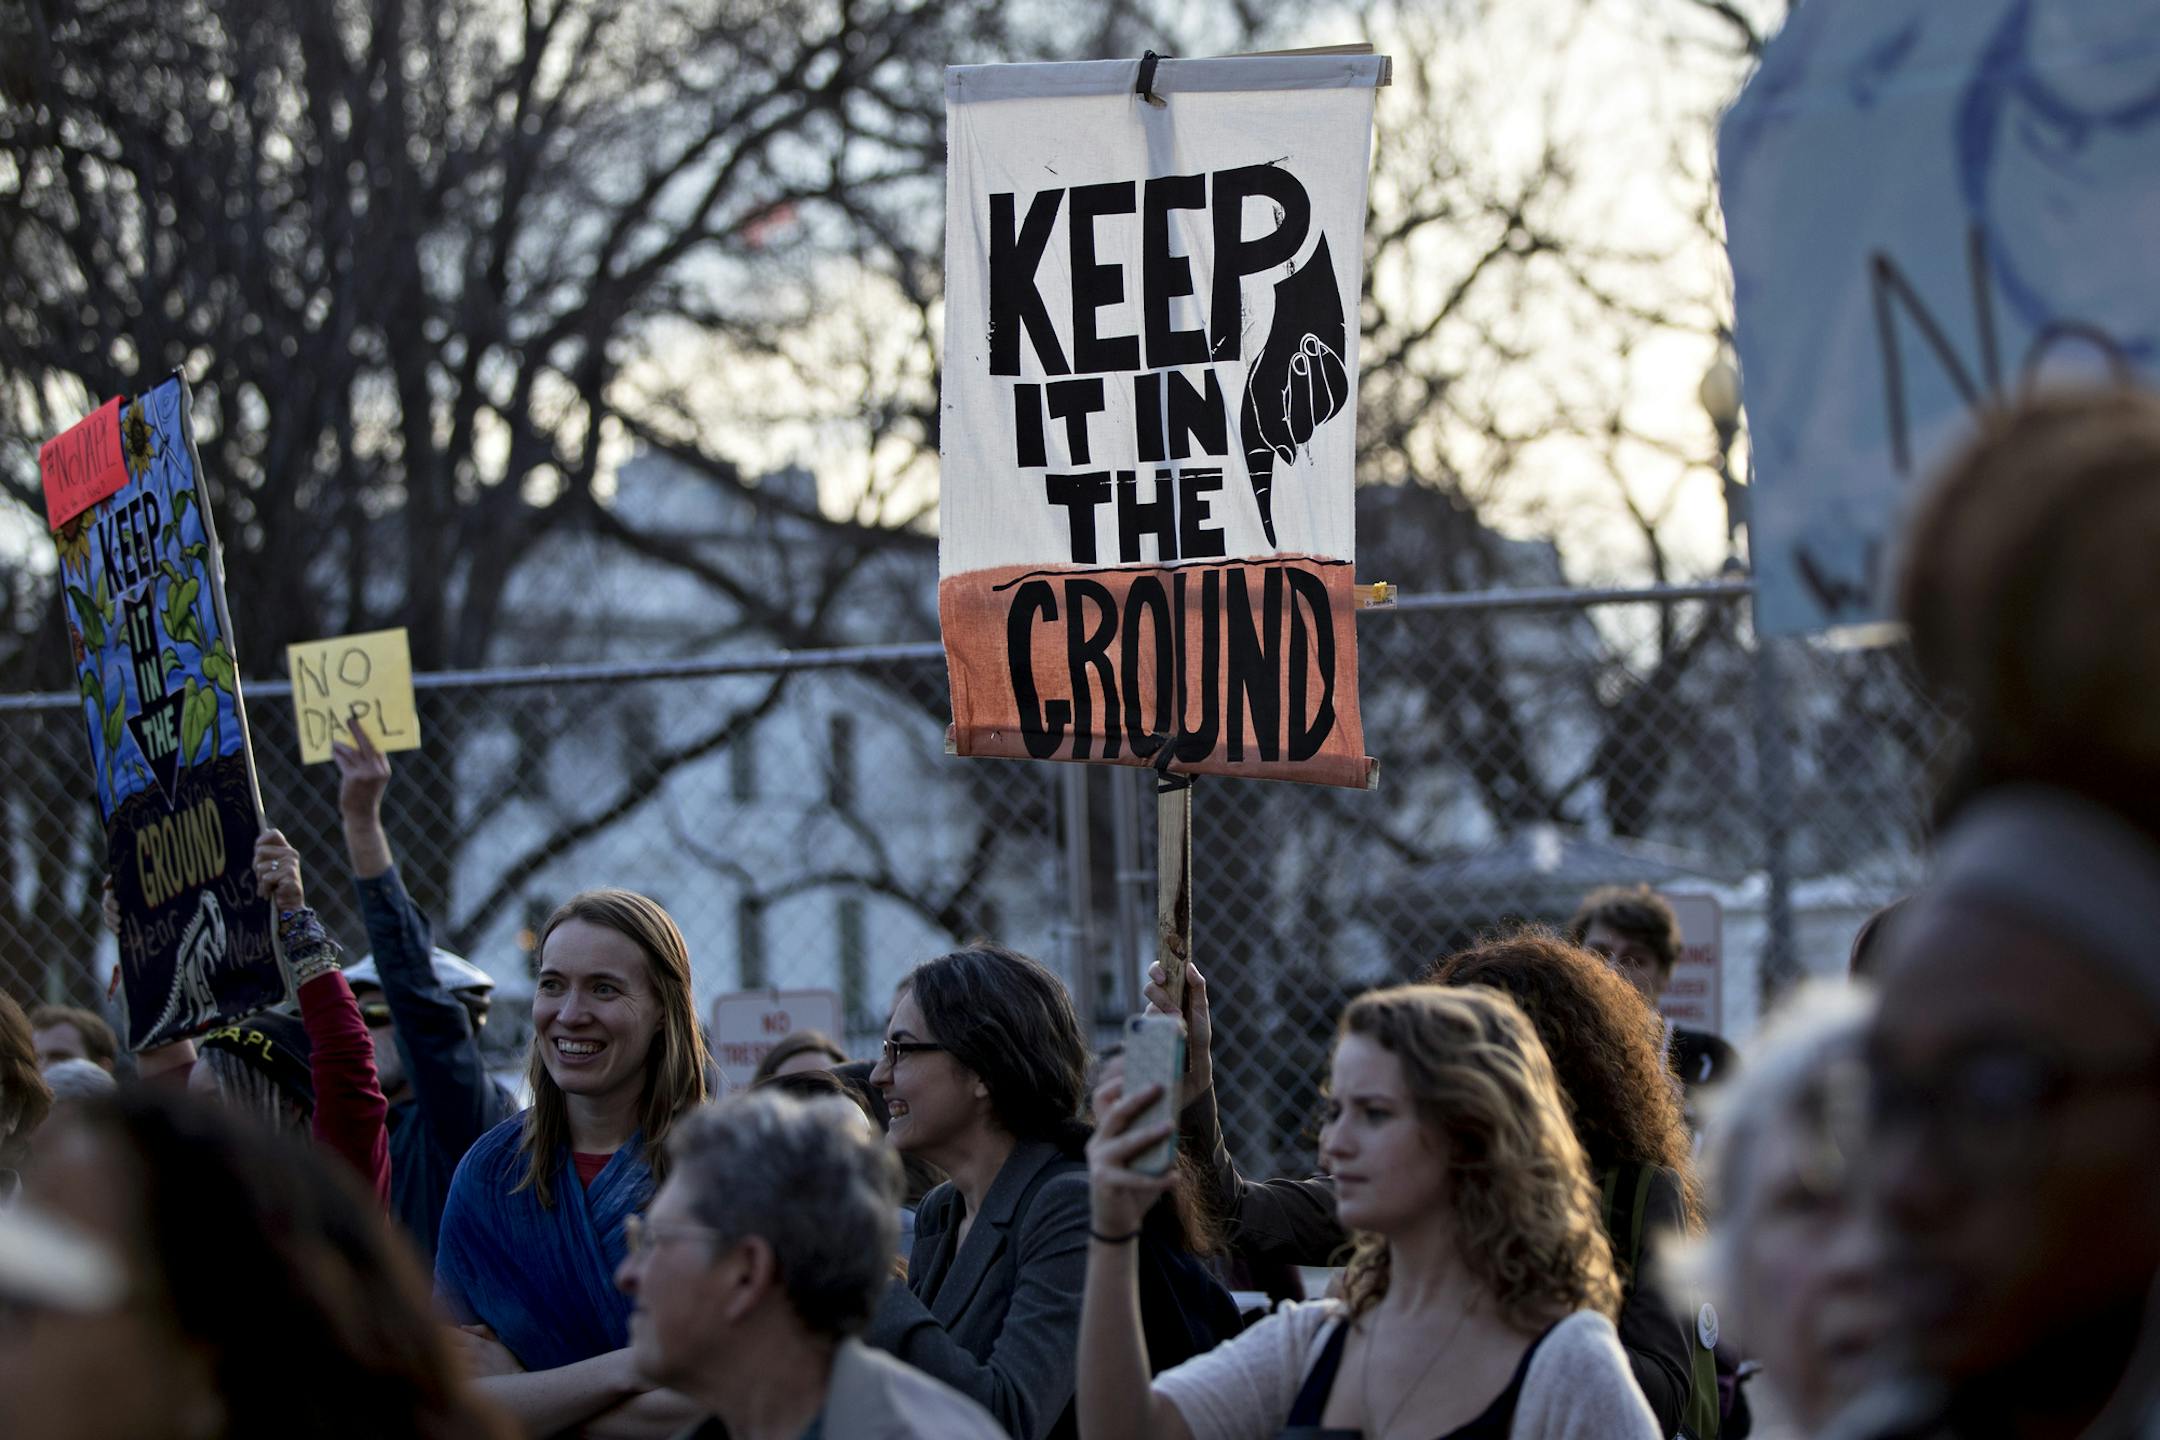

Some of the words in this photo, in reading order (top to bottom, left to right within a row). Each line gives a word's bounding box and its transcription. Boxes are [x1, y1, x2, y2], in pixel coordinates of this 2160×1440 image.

[989, 164, 1311, 377] KEEP
[1014, 378, 1104, 467] IT
[1134, 369, 1228, 463] IN
[98, 491, 161, 600] KEEP
[1046, 467, 1226, 564] THE
[131, 605, 151, 653] IT
[1007, 567, 1336, 763] GROUND
[139, 656, 163, 703] IN
[298, 647, 372, 704] NO
[141, 703, 179, 761] THE
[304, 698, 404, 751] DAPL
[136, 797, 226, 911] GROUND
[763, 1011, 790, 1033] NO
